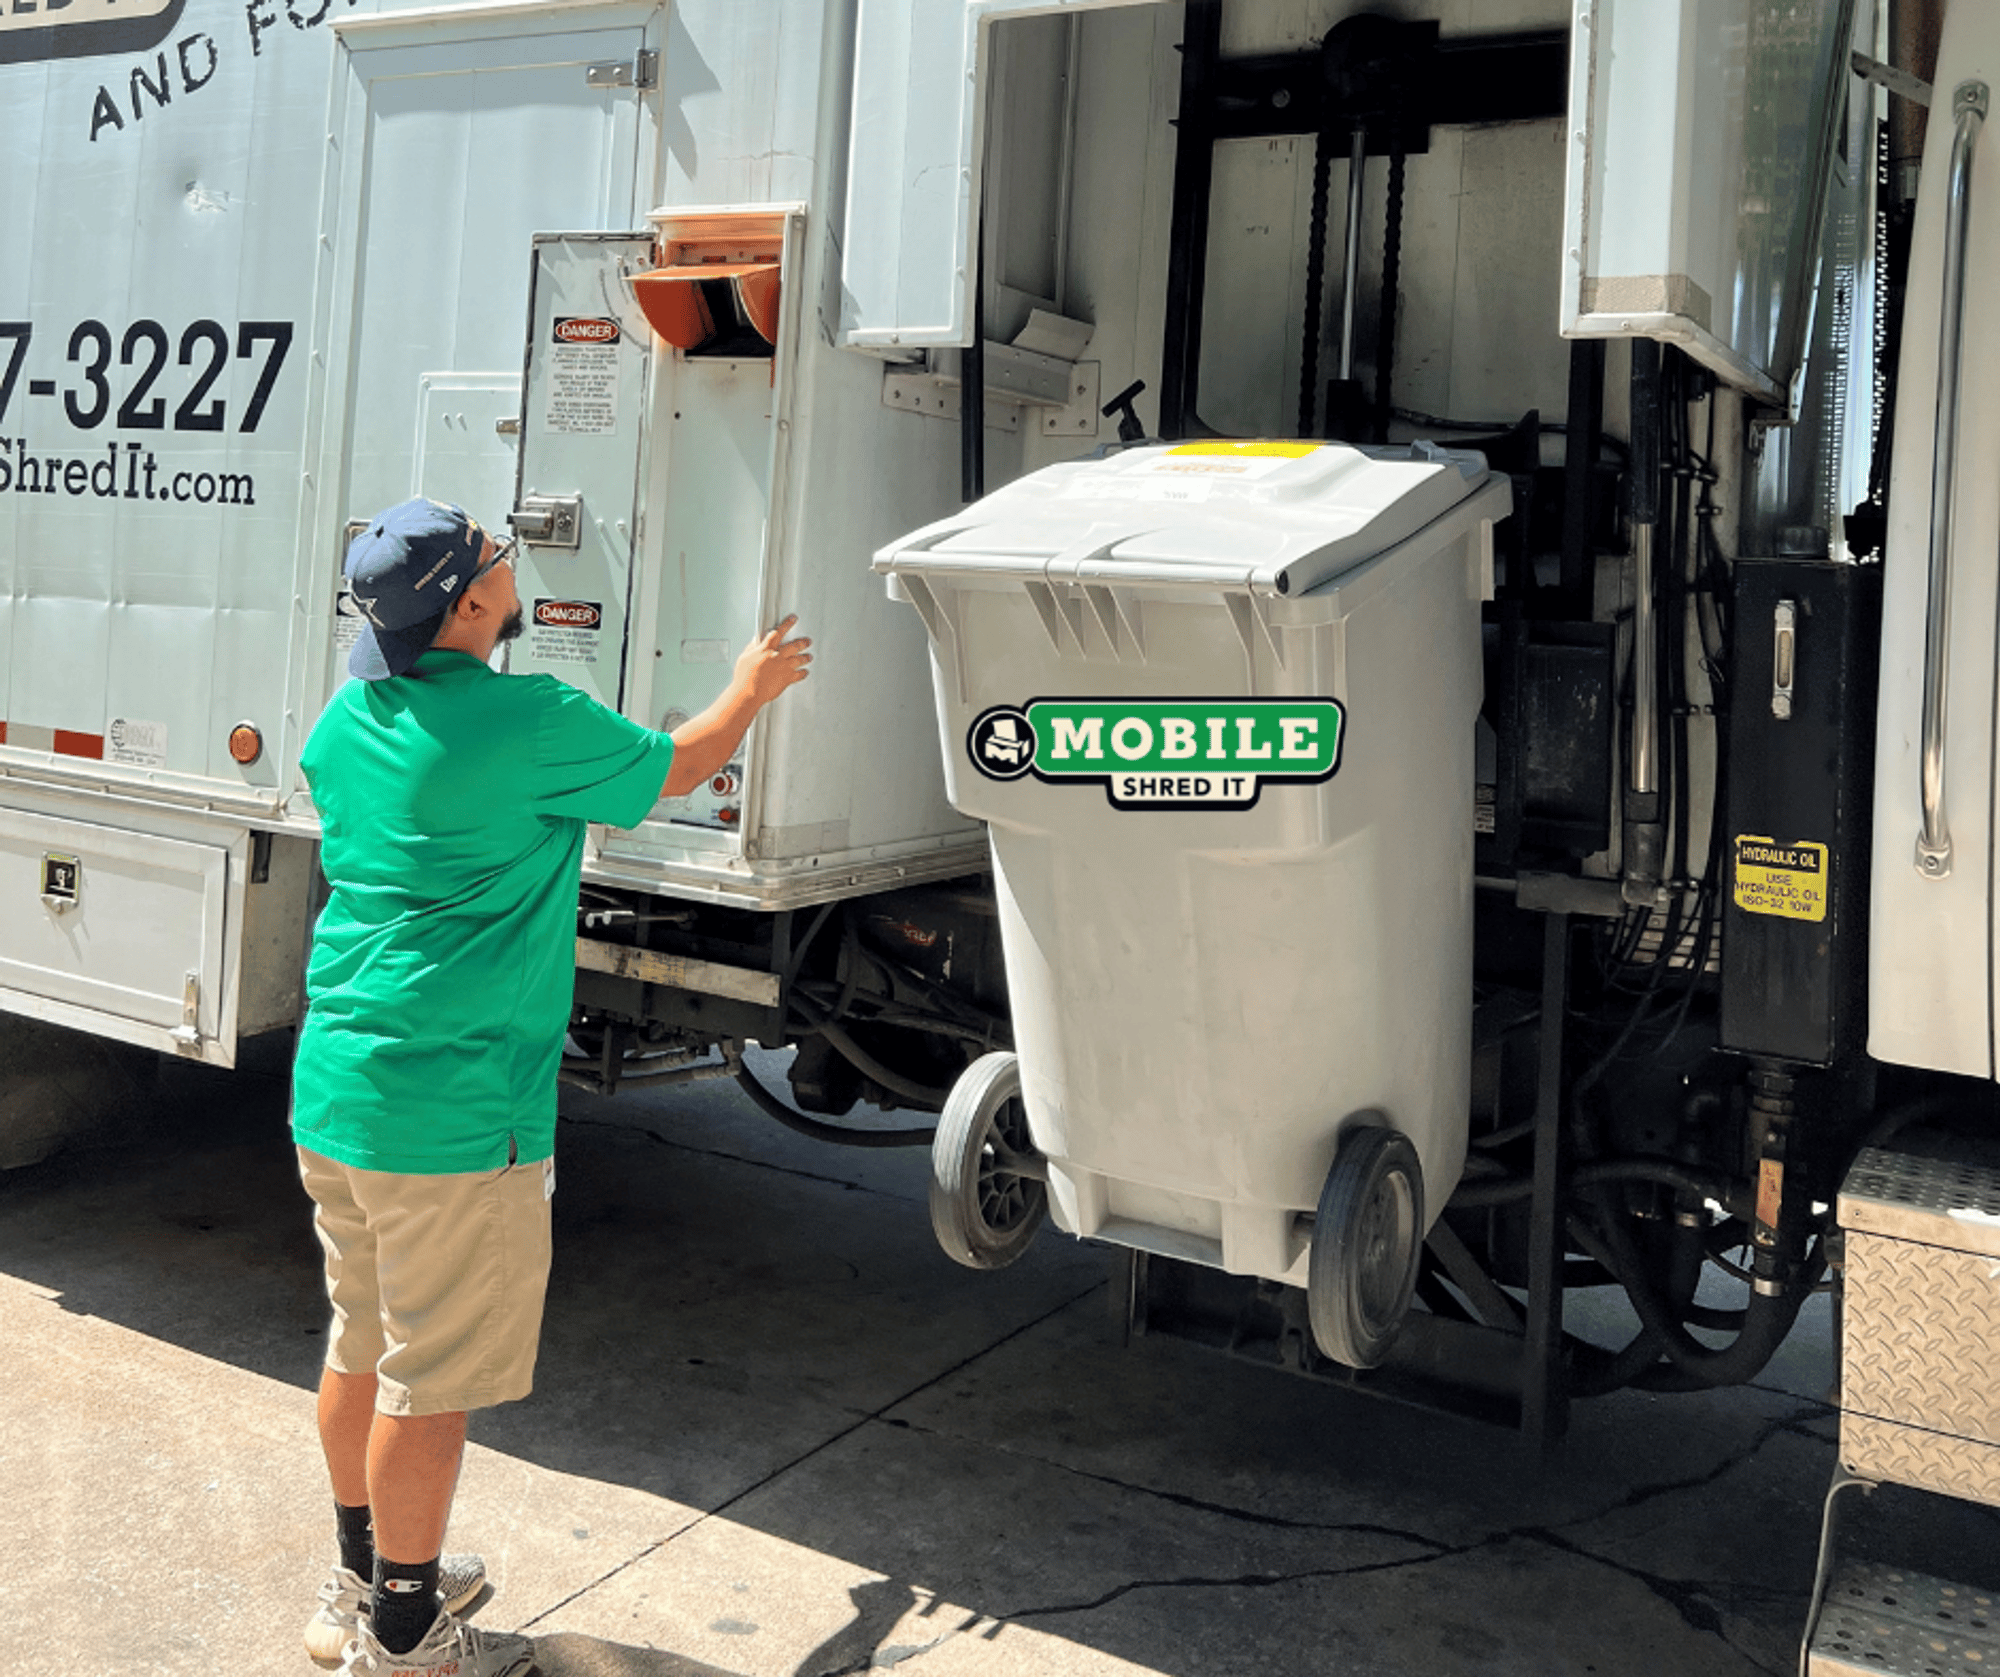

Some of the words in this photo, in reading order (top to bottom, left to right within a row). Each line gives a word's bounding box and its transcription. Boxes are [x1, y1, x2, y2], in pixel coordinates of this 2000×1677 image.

[89, 32, 217, 142] AND
[561, 325, 612, 338] DANGER
[542, 606, 593, 622] DANGER
[1050, 716, 1319, 761] MOBILE
[1123, 777, 1212, 797] SHRED
[1223, 777, 1246, 797] IT
[1742, 845, 1797, 865] HYDRAULIC
[1766, 873, 1793, 886] USE
